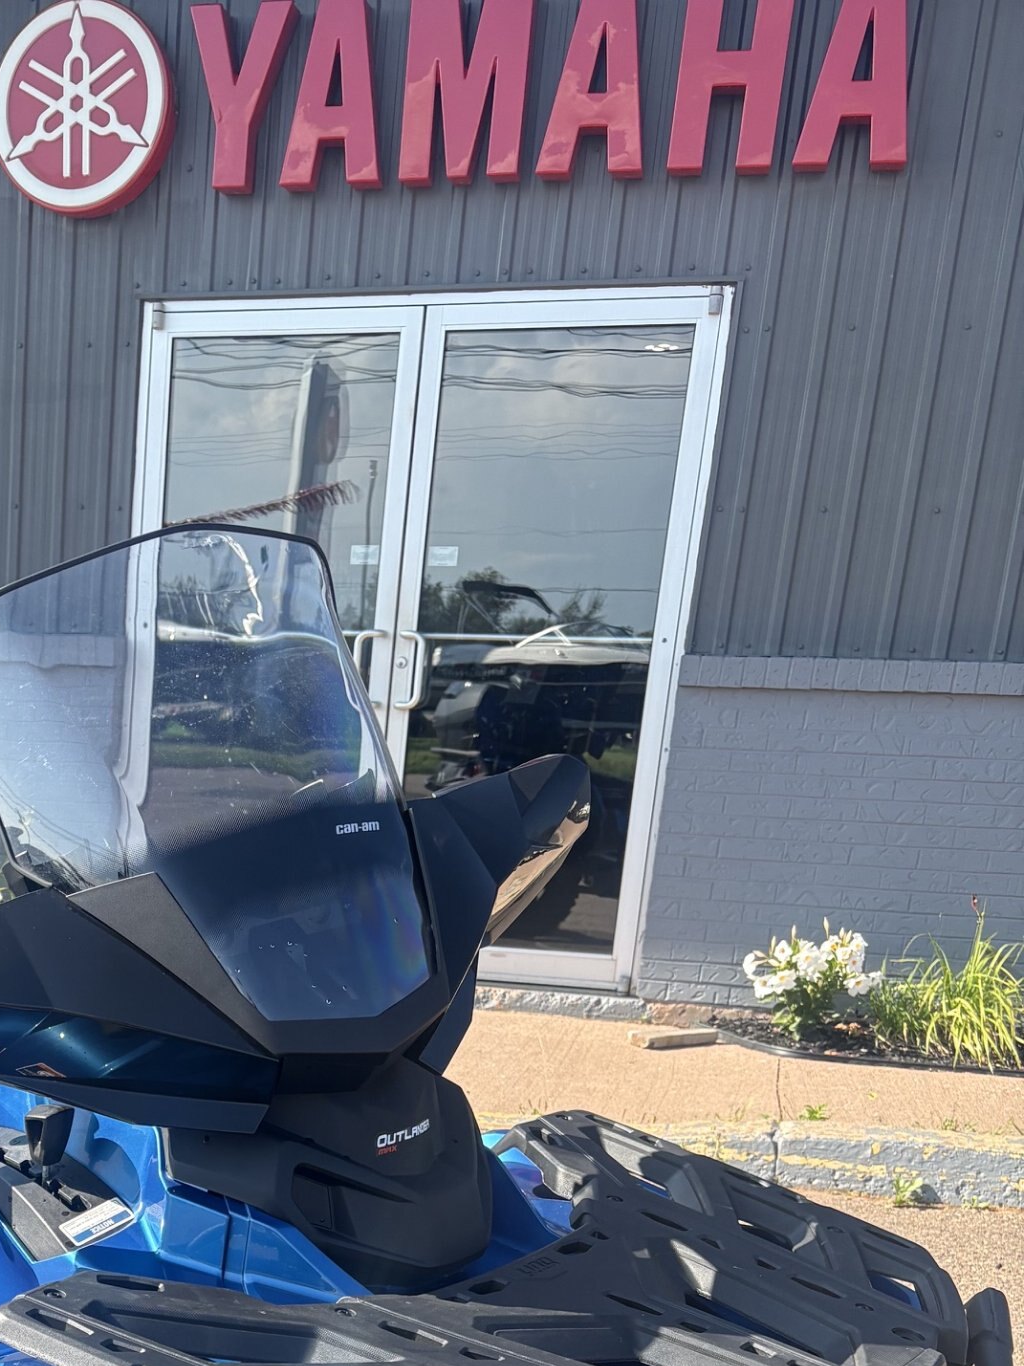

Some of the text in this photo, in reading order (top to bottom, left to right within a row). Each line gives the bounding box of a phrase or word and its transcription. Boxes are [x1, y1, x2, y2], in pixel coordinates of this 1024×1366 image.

[192, 0, 908, 195] YAMAHA
[336, 821, 380, 835] can-am
[376, 1118, 430, 1149] OUTLANDER
[90, 1218, 115, 1235] NOTICE
